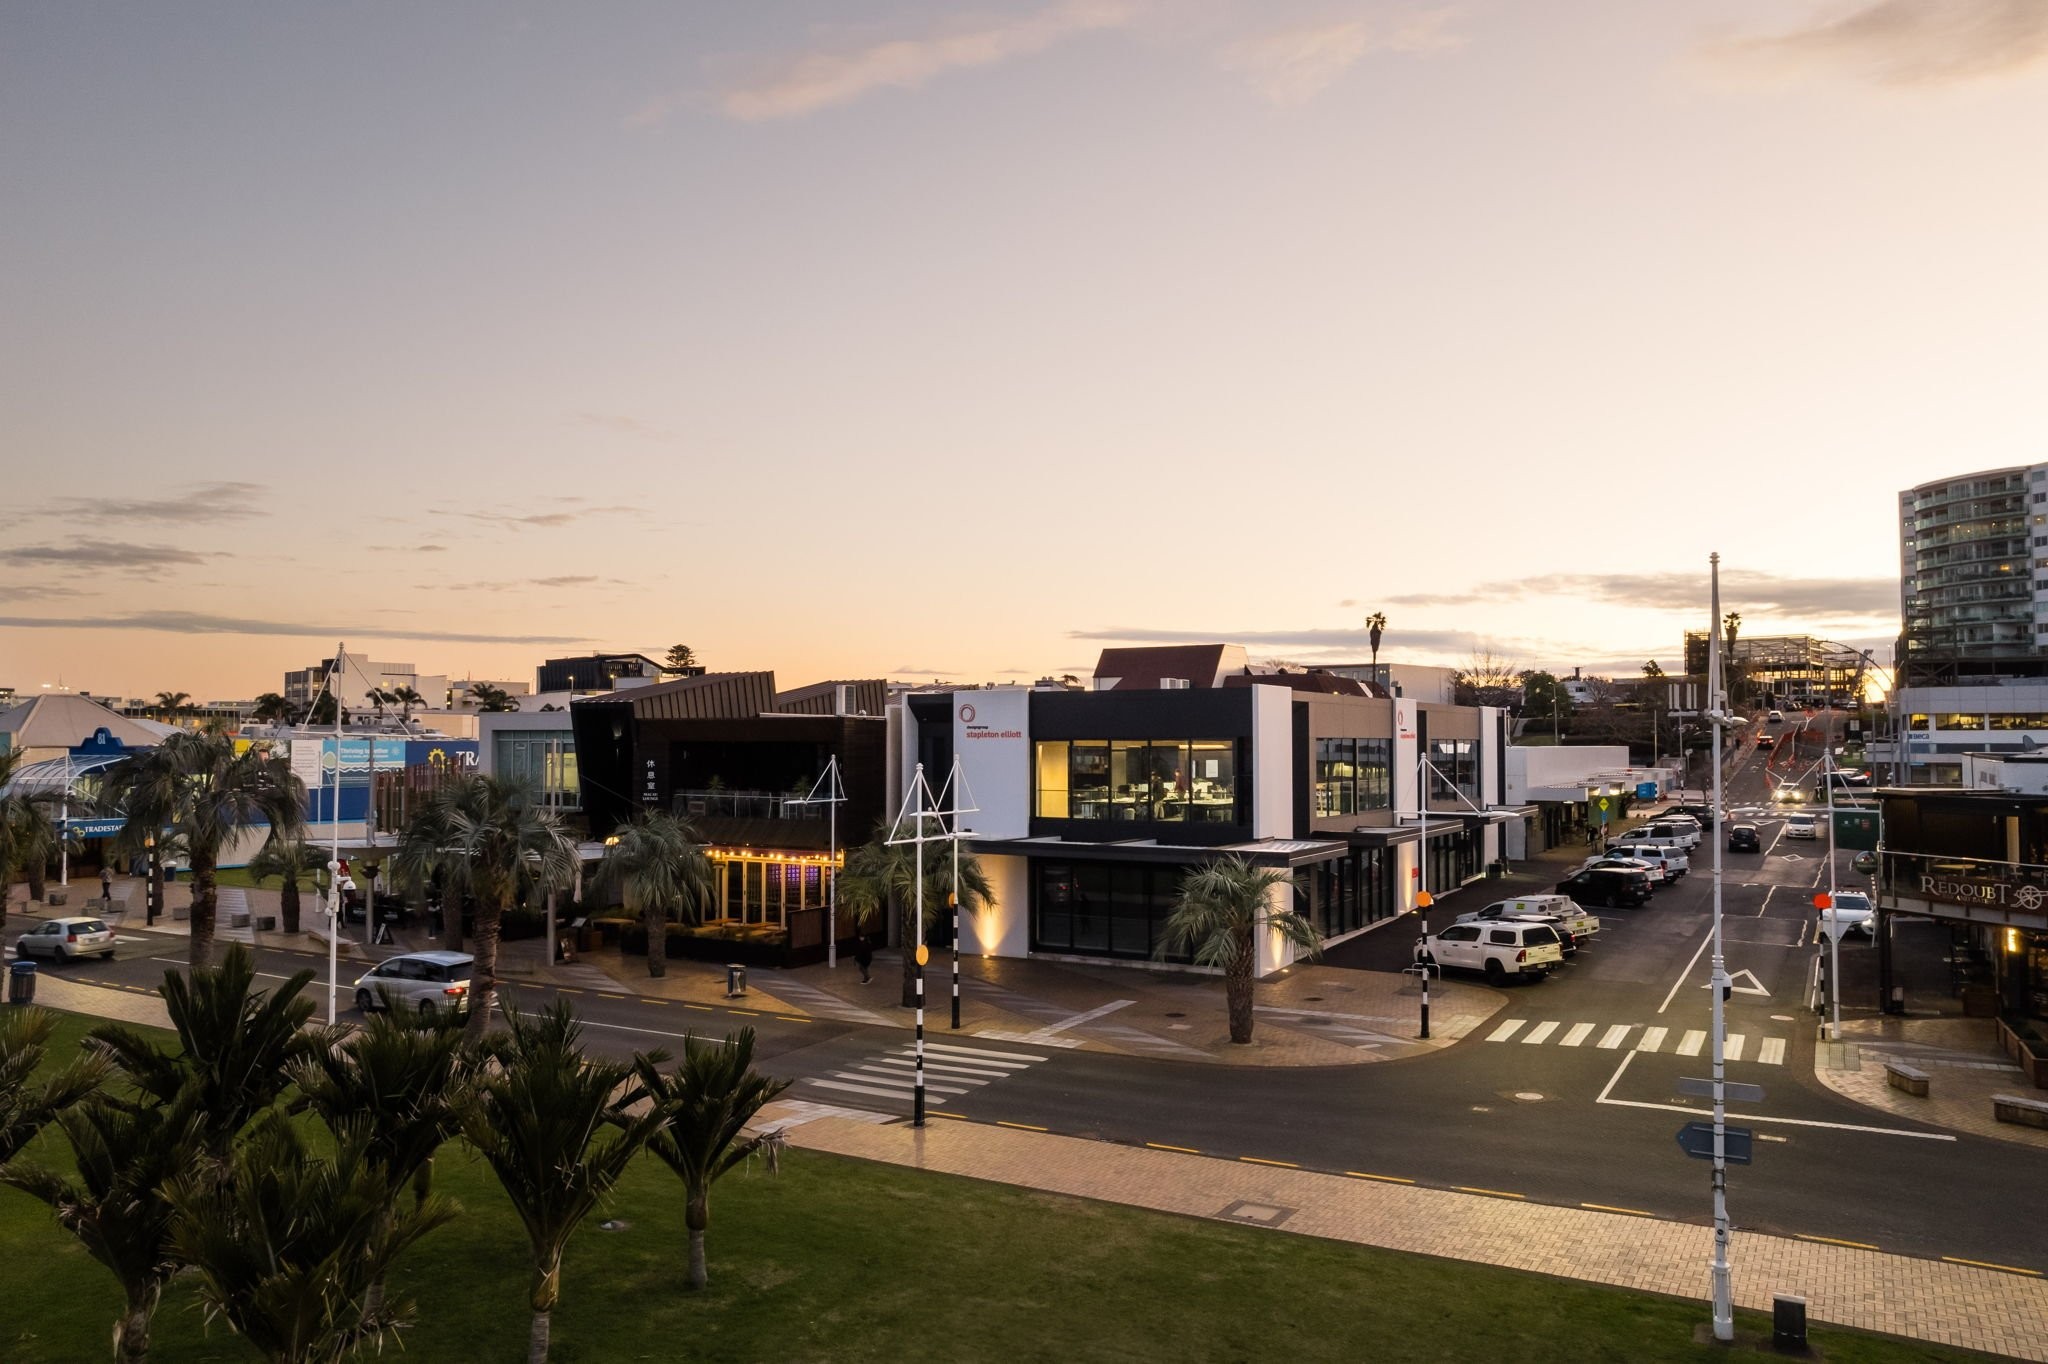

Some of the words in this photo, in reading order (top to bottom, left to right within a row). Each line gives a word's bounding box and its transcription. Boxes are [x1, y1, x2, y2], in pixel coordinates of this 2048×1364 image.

[98, 733, 106, 744] 81
[966, 731, 999, 739] stapleton
[1920, 875, 2012, 905] REDOUBT
